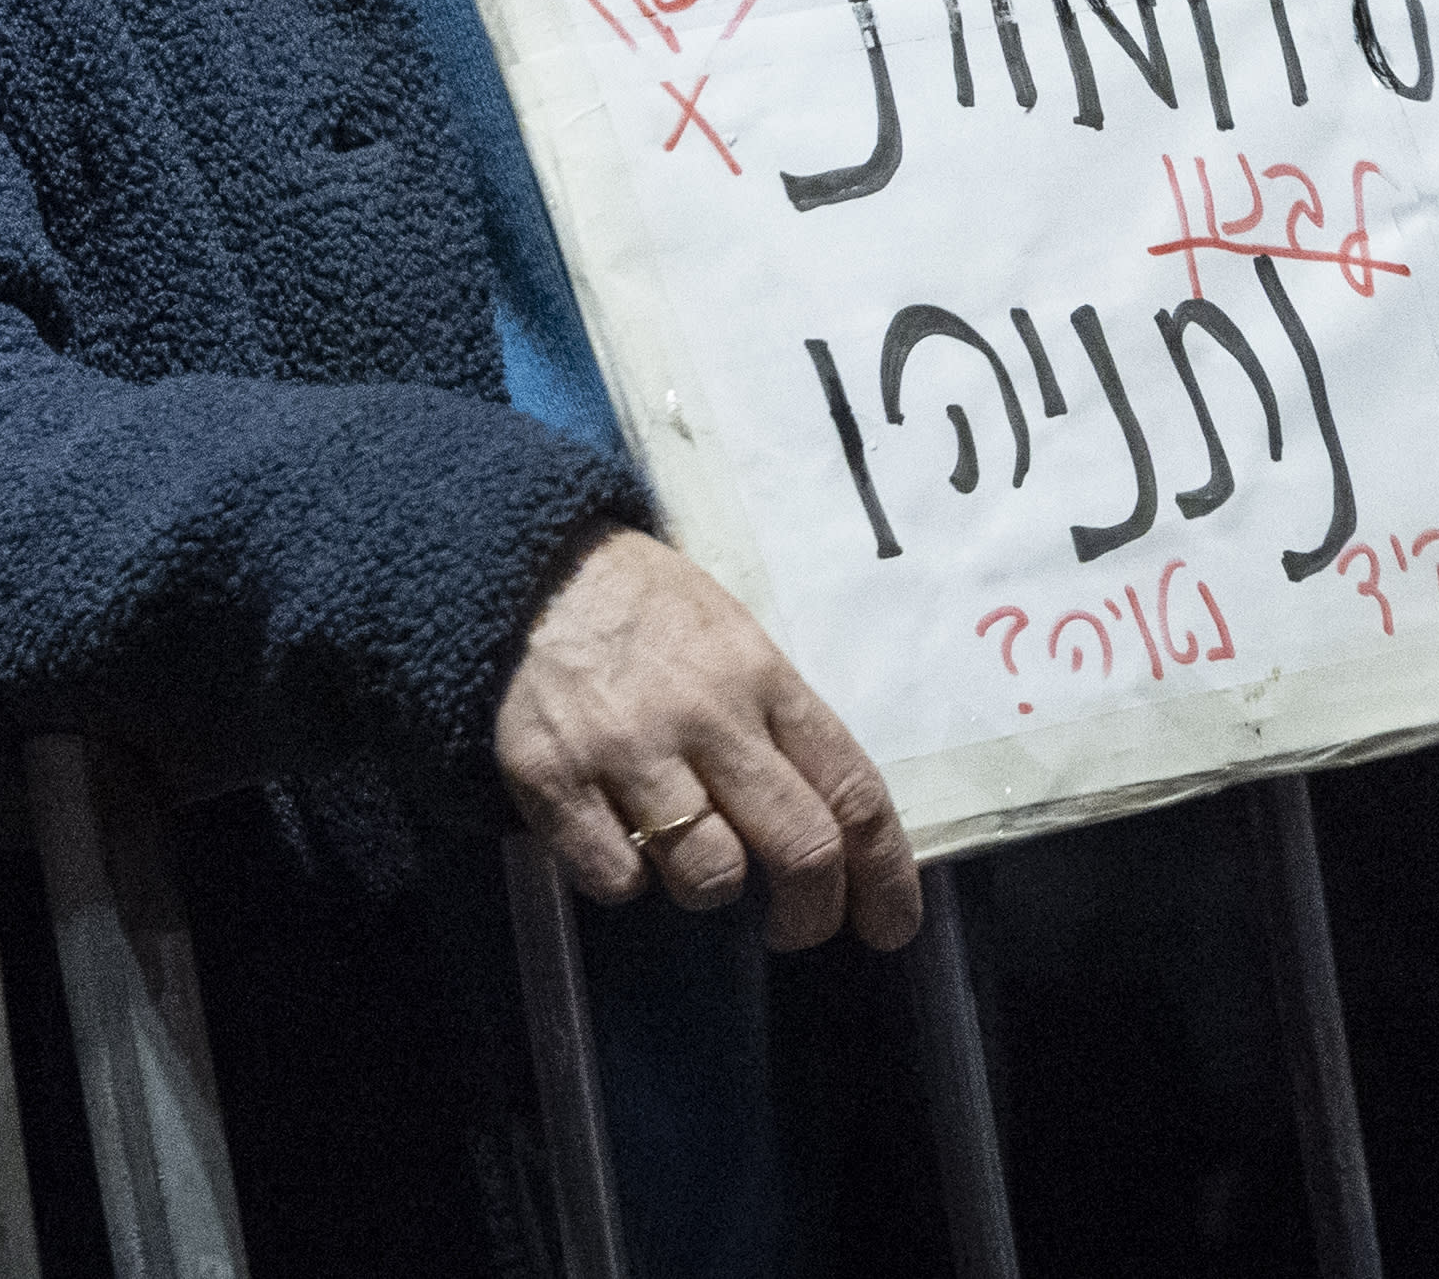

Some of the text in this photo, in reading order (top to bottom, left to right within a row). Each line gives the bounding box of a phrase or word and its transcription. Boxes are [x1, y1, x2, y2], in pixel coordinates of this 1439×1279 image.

[1160, 152, 1382, 300] לבנון
[803, 252, 1358, 583] נתניהו
[976, 559, 1237, 715] נטויה?
